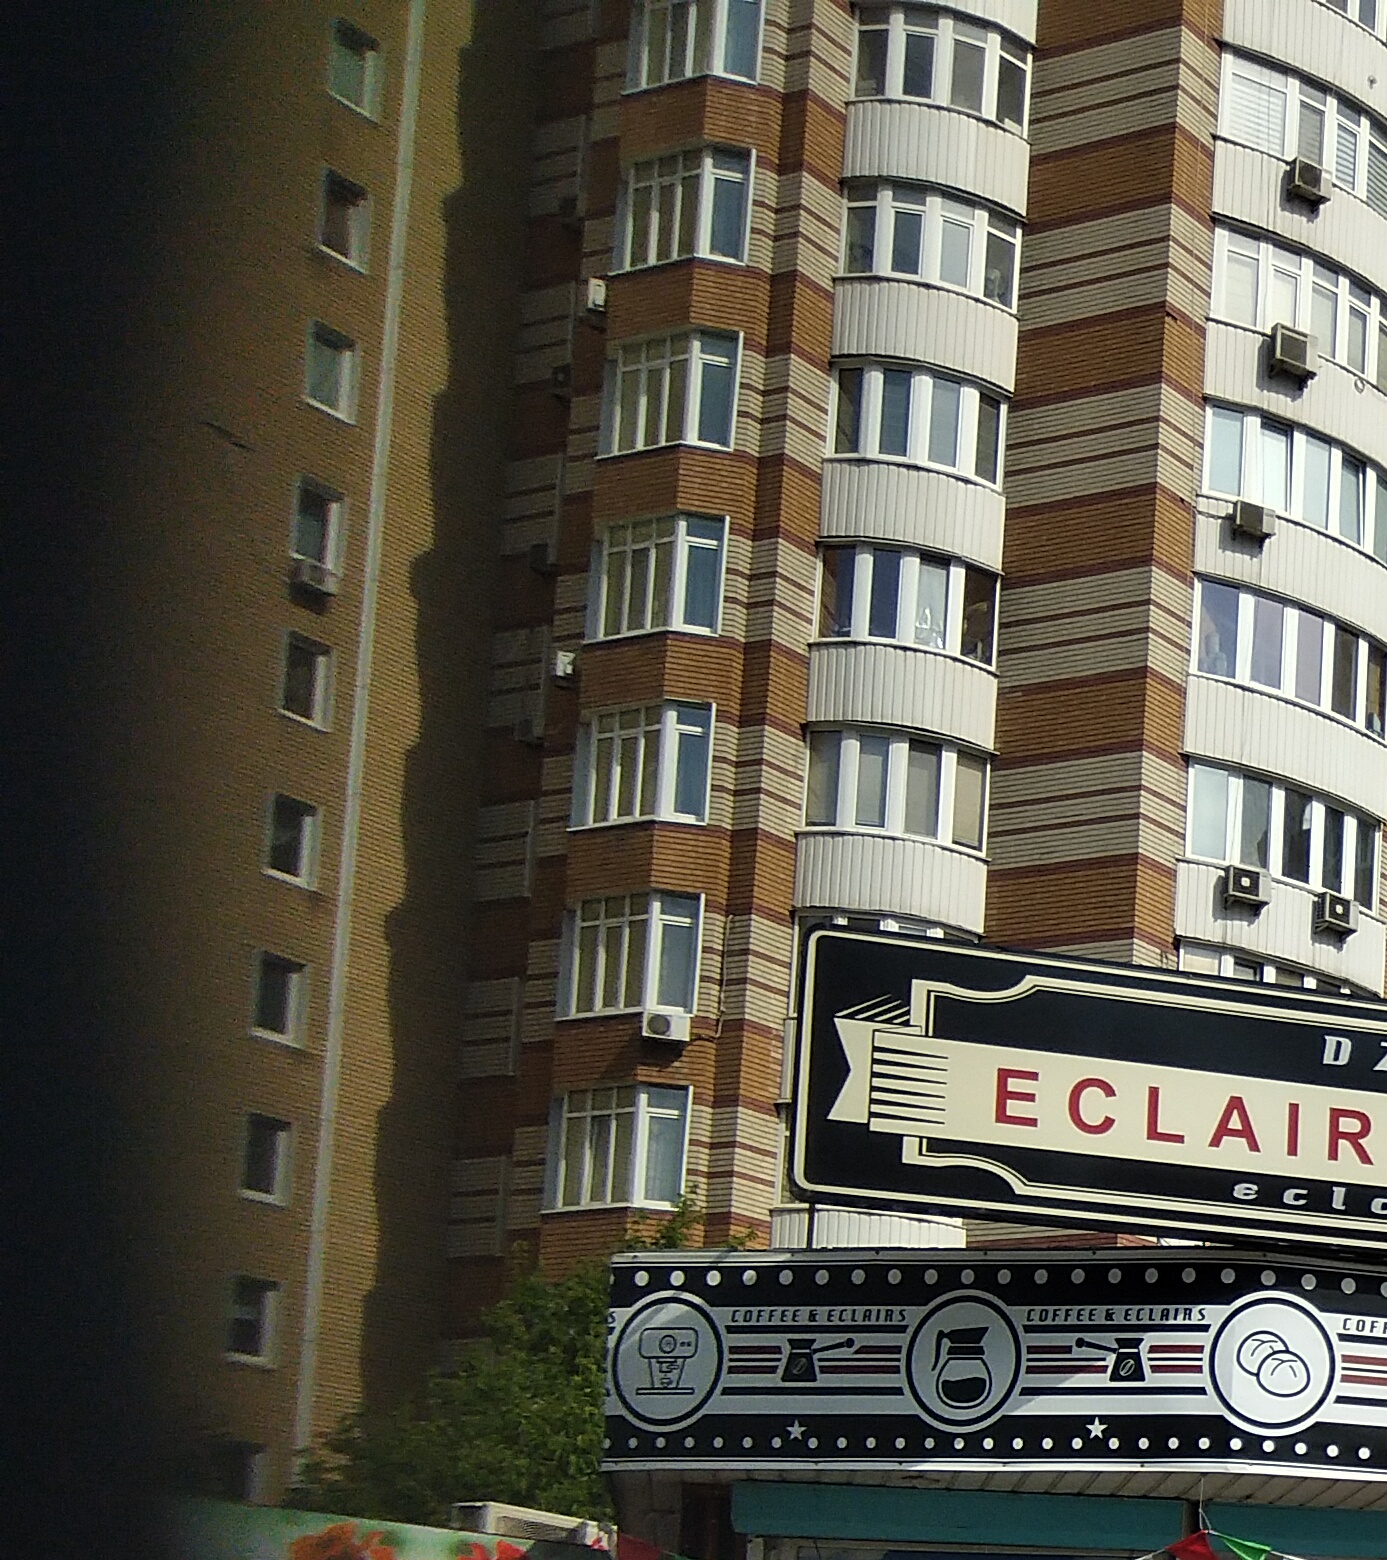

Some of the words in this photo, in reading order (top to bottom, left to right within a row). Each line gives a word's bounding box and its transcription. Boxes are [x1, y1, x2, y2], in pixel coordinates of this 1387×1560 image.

[729, 1308, 802, 1323] COFFEE
[825, 1308, 909, 1323] ECLAIRS
[1025, 1307, 1100, 1323] COFFEE
[1122, 1307, 1208, 1323] ECLAIRS
